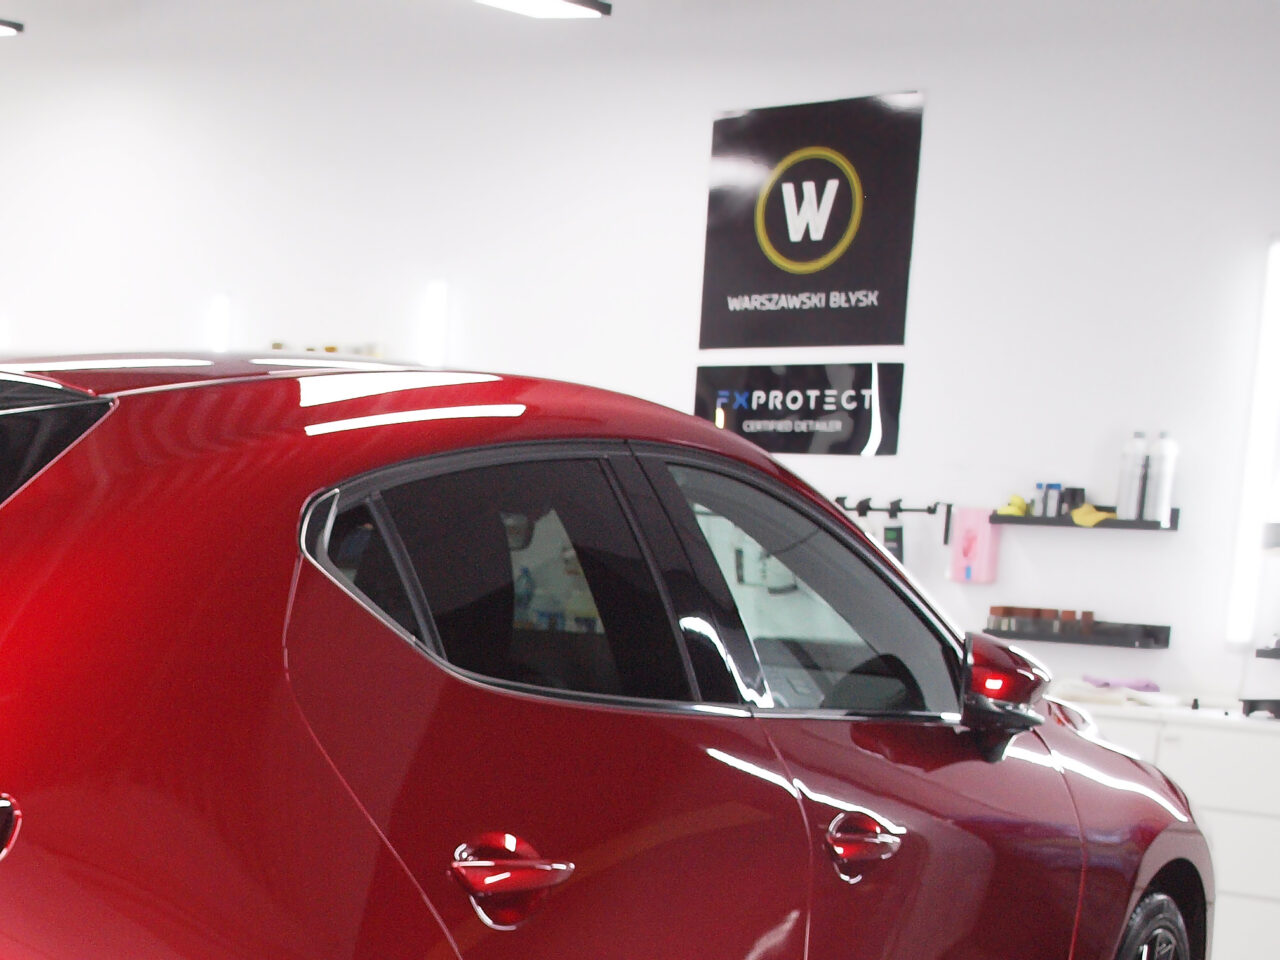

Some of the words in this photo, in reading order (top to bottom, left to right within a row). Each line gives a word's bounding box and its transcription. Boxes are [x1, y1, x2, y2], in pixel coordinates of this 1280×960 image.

[781, 179, 839, 242] W
[727, 291, 825, 311] WARSZAWSKI
[829, 290, 879, 309] BŁYSK
[716, 389, 873, 411] FXPROTECT
